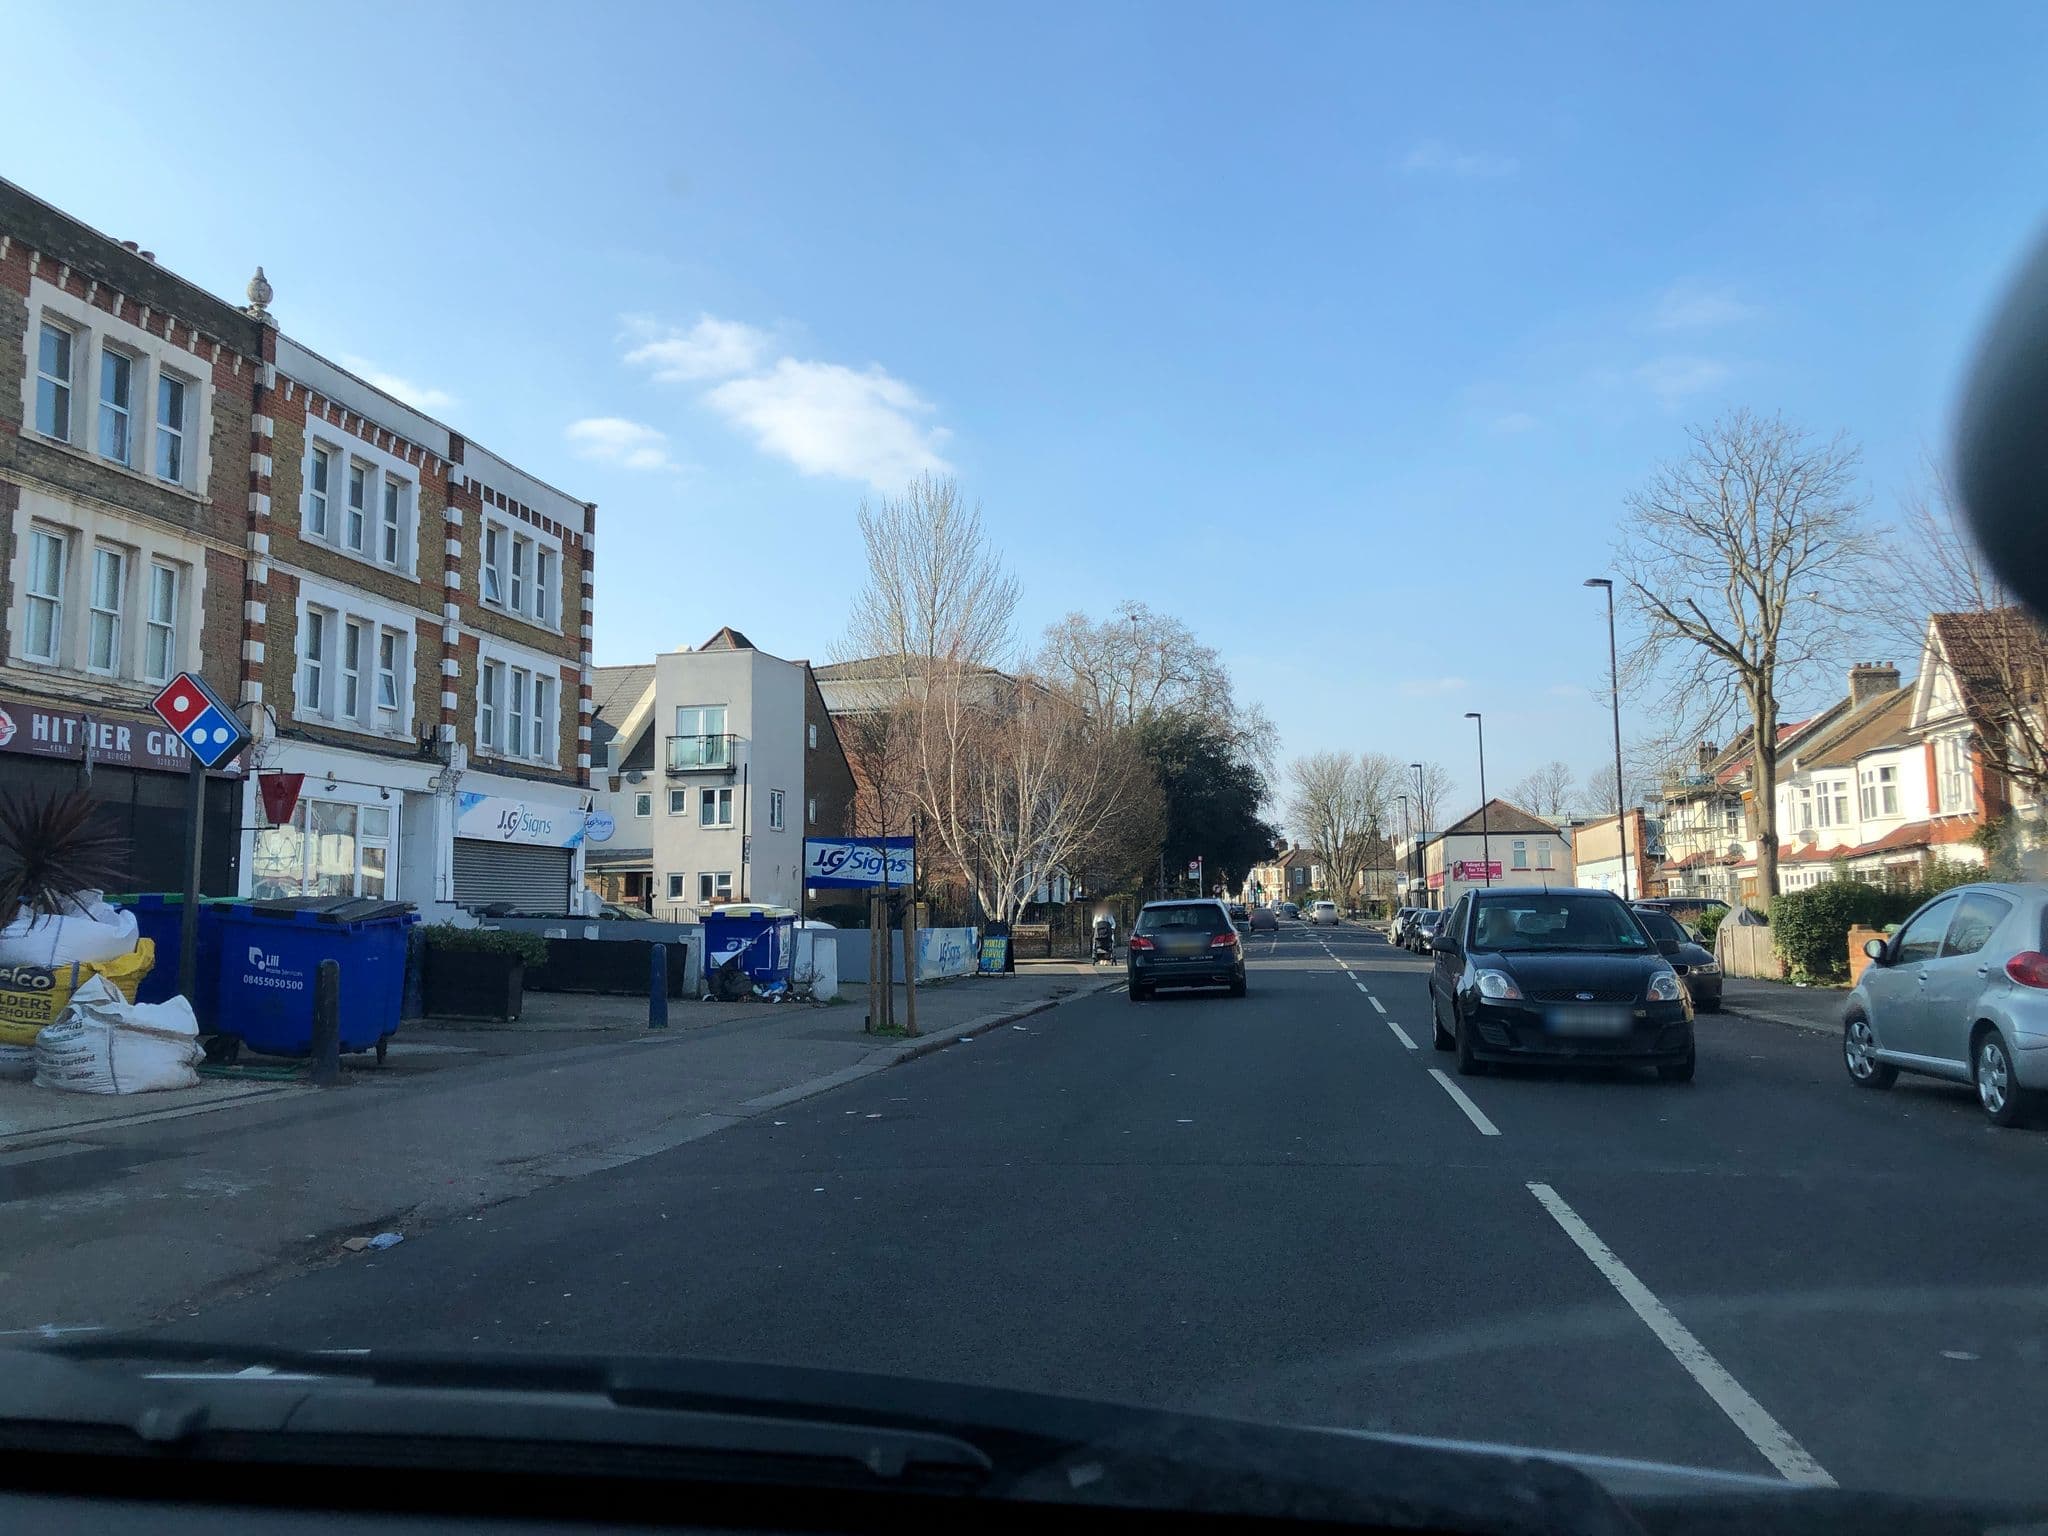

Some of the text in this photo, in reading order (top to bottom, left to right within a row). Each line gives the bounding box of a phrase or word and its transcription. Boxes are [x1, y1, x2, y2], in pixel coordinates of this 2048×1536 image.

[521, 813, 552, 838] Signs
[850, 851, 907, 876] Signs
[265, 954, 280, 967] Lill
[0, 966, 50, 988] elco
[0, 993, 52, 1011] LDERS
